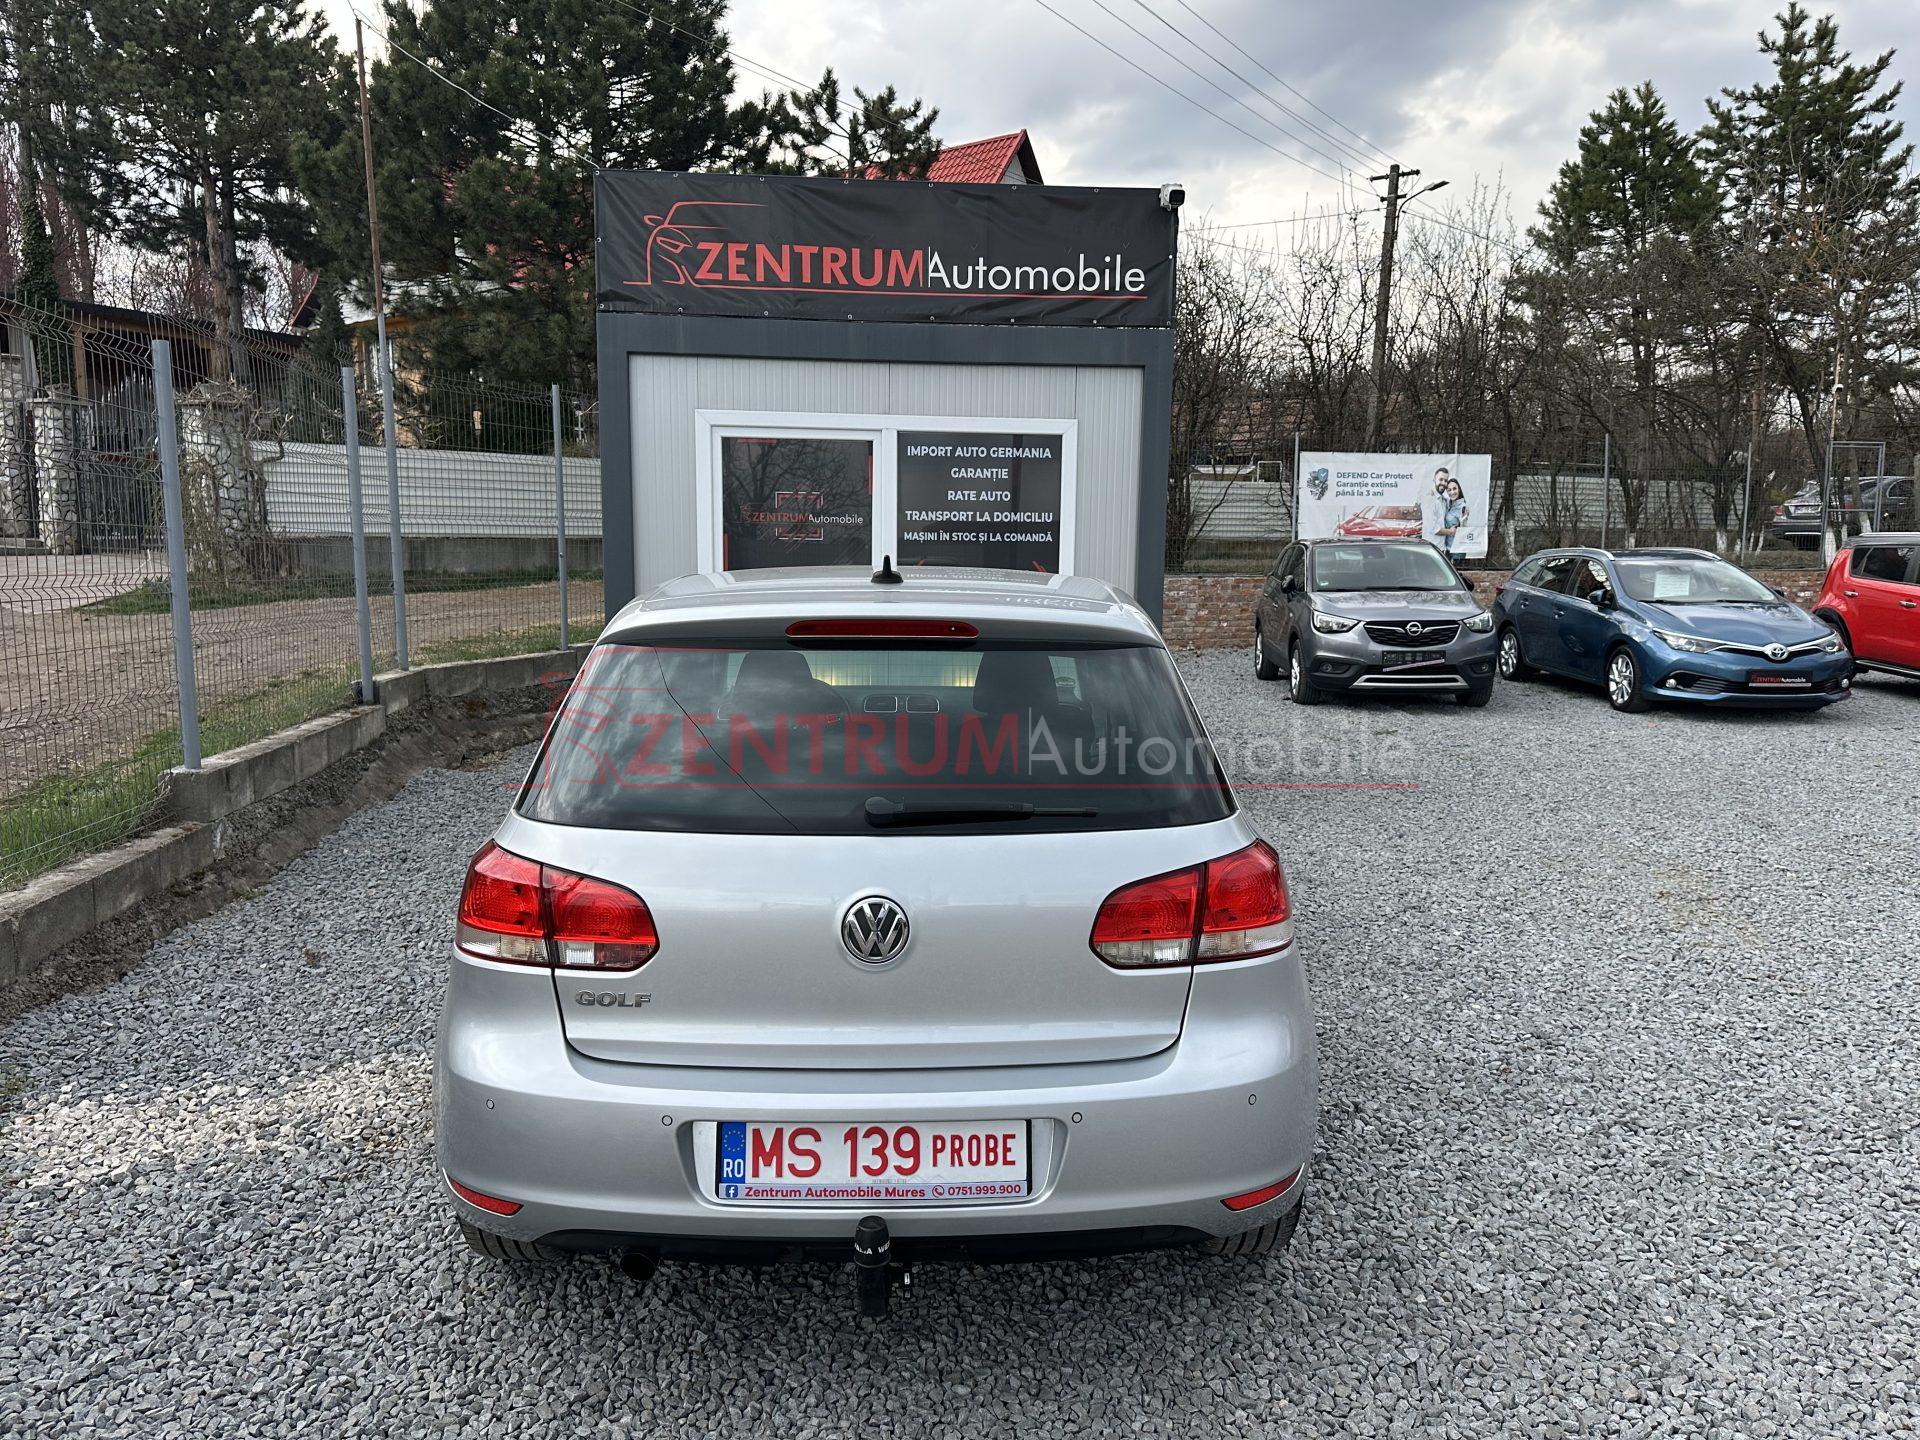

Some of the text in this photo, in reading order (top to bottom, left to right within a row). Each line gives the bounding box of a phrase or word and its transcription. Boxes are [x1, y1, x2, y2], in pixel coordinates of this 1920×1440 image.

[696, 242, 1146, 292] ZENTRUM Automobile
[907, 446, 1052, 459] IMPORT AUTO GERMANIA
[951, 468, 1009, 482] GARANȚIE
[1385, 472, 1413, 480] Protect
[947, 491, 1011, 501] RATE AUTO
[1356, 489, 1364, 497] la
[752, 512, 863, 524] ZENTRUM Automobile
[905, 511, 1053, 522] TRANSPORT LA DOMICILIU
[904, 530, 1053, 544] MAȘINI ÎN STOC ȘI LA COMANDĂ
[575, 990, 652, 1008] GOLF
[723, 1125, 1017, 1179] RO MS 139 PROBE
[744, 1184, 1021, 1198] Zentrum Automobile Mures 0751.999.900
